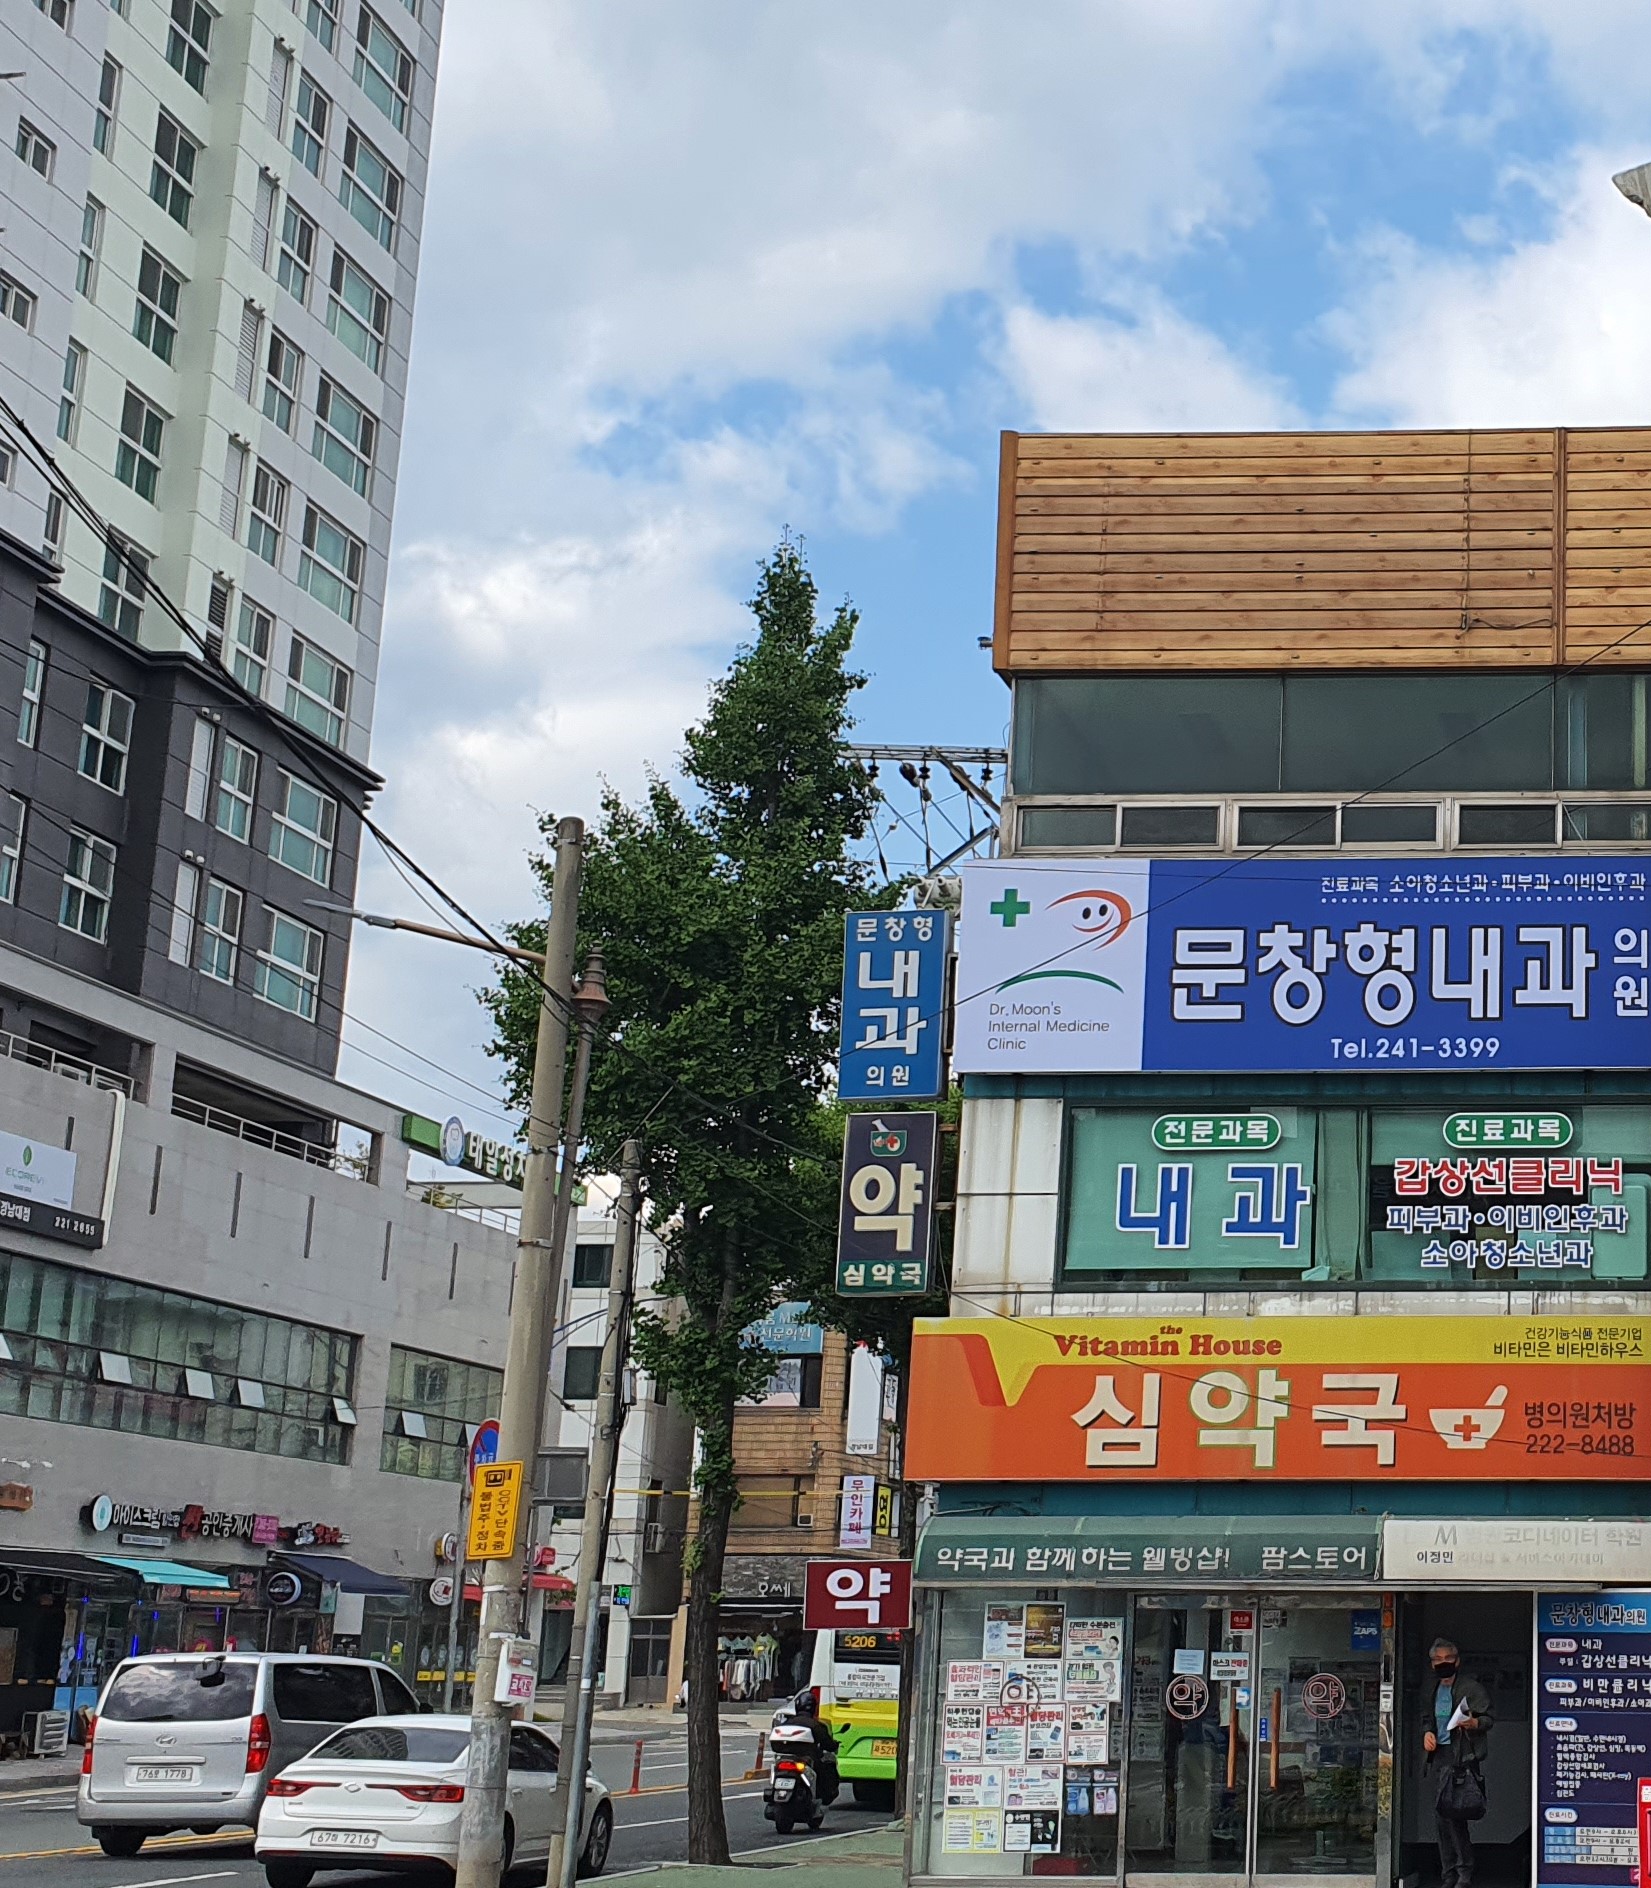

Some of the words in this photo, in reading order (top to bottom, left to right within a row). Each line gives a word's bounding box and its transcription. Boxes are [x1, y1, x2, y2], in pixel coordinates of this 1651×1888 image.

[1321, 875, 1379, 893] 진료과목
[856, 916, 934, 943] 문창형
[1169, 921, 1598, 1027] 문창형내과
[1613, 927, 1649, 1018] 의원
[855, 949, 928, 1056] 내과
[989, 1003, 1009, 1016] Dr.
[1012, 1001, 1061, 1015] Moon's
[988, 1020, 1041, 1032] Internal
[1046, 1020, 1110, 1032] Medicine
[987, 1037, 1027, 1050] Clinic
[1331, 1037, 1500, 1059] Tel.241-3399
[866, 1065, 910, 1088] 의원
[1161, 1119, 1271, 1145] 전문과목
[1455, 1118, 1561, 1142] 진료과목
[1394, 1157, 1622, 1196] 갑상선클리닉
[849, 1162, 925, 1253] 약
[1114, 1161, 1312, 1250] 내과
[1421, 1239, 1594, 1269] 소아청소년과
[842, 1262, 923, 1287] 심약국
[1053, 1334, 1180, 1356] Vitamin
[1189, 1334, 1283, 1356] House
[1597, 1327, 1643, 1340] 전문기업
[1493, 1342, 1551, 1358] 비타민은
[1556, 1342, 1644, 1358] 비타민하우스
[1071, 1367, 1408, 1470] 심약국
[1524, 1402, 1637, 1430] 병의원처방
[1526, 1434, 1635, 1456] 222-8488
[113, 1504, 161, 1530] 아이스크림
[849, 1479, 866, 1535] 무인카페
[201, 1512, 254, 1538] 공인중개사
[1503, 1526, 1599, 1545] 코디네이터
[1606, 1527, 1642, 1546] 학원
[937, 1547, 1014, 1571] 약국과
[1261, 1546, 1366, 1571] 팜스토어
[1417, 1551, 1454, 1564] 이정민
[826, 1567, 891, 1624] 약
[1581, 1638, 1603, 1651] 내과
